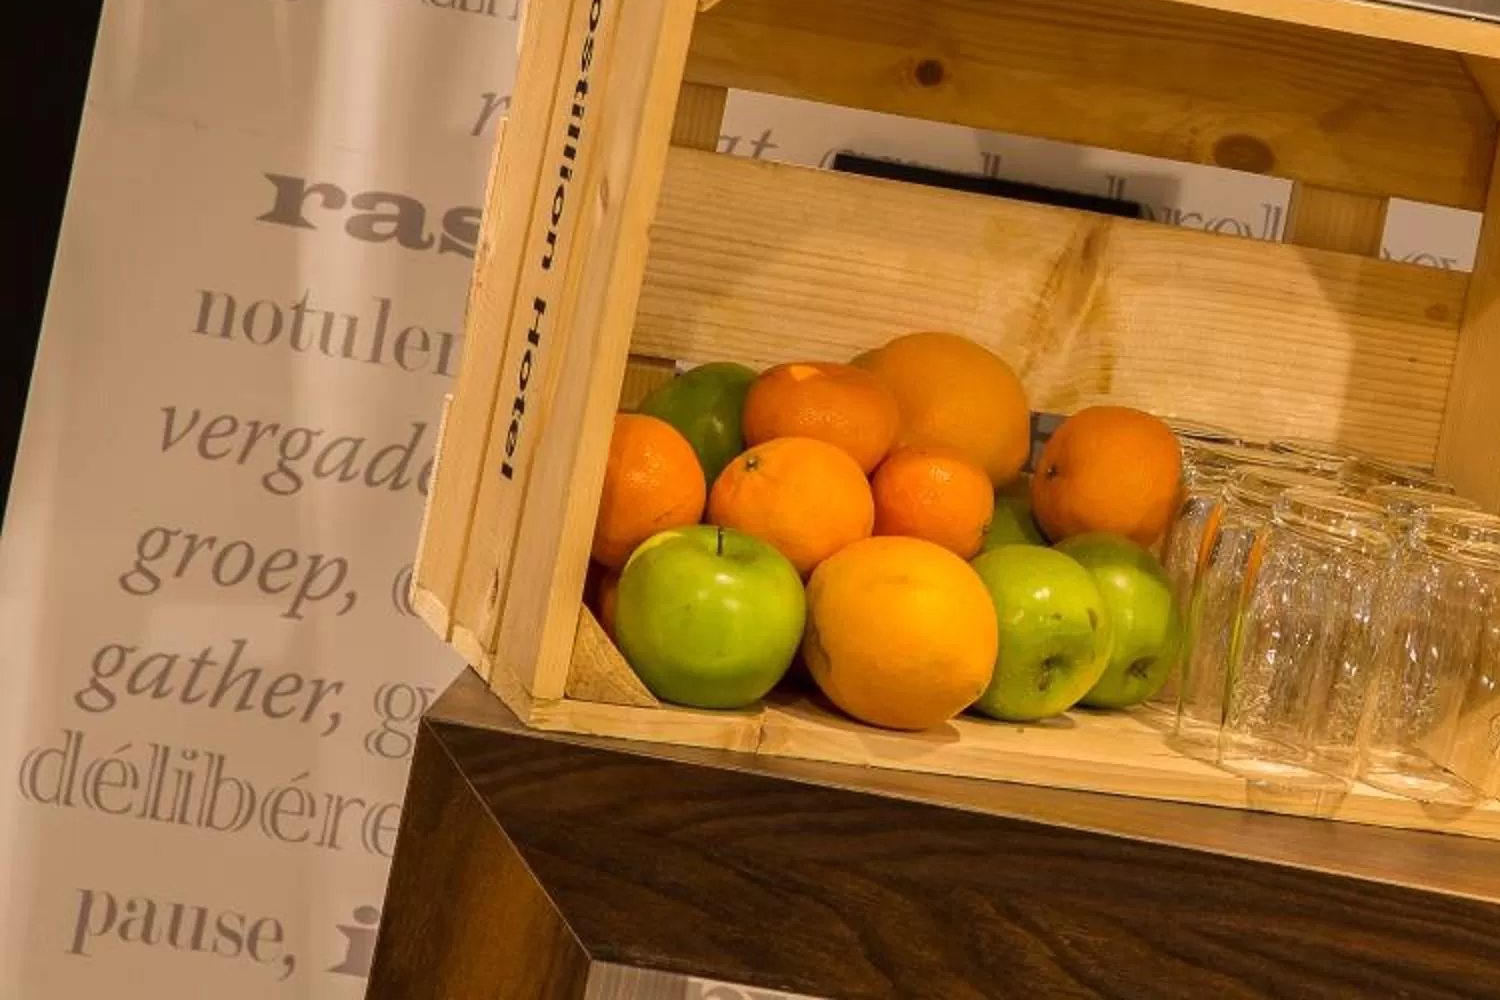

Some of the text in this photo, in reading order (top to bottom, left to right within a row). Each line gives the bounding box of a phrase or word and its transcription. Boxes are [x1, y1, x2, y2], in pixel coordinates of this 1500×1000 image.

[501, 297, 547, 481] Hotel
[117, 524, 358, 620] groep,
[73, 639, 344, 738] gather,
[64, 887, 298, 982] pause,
